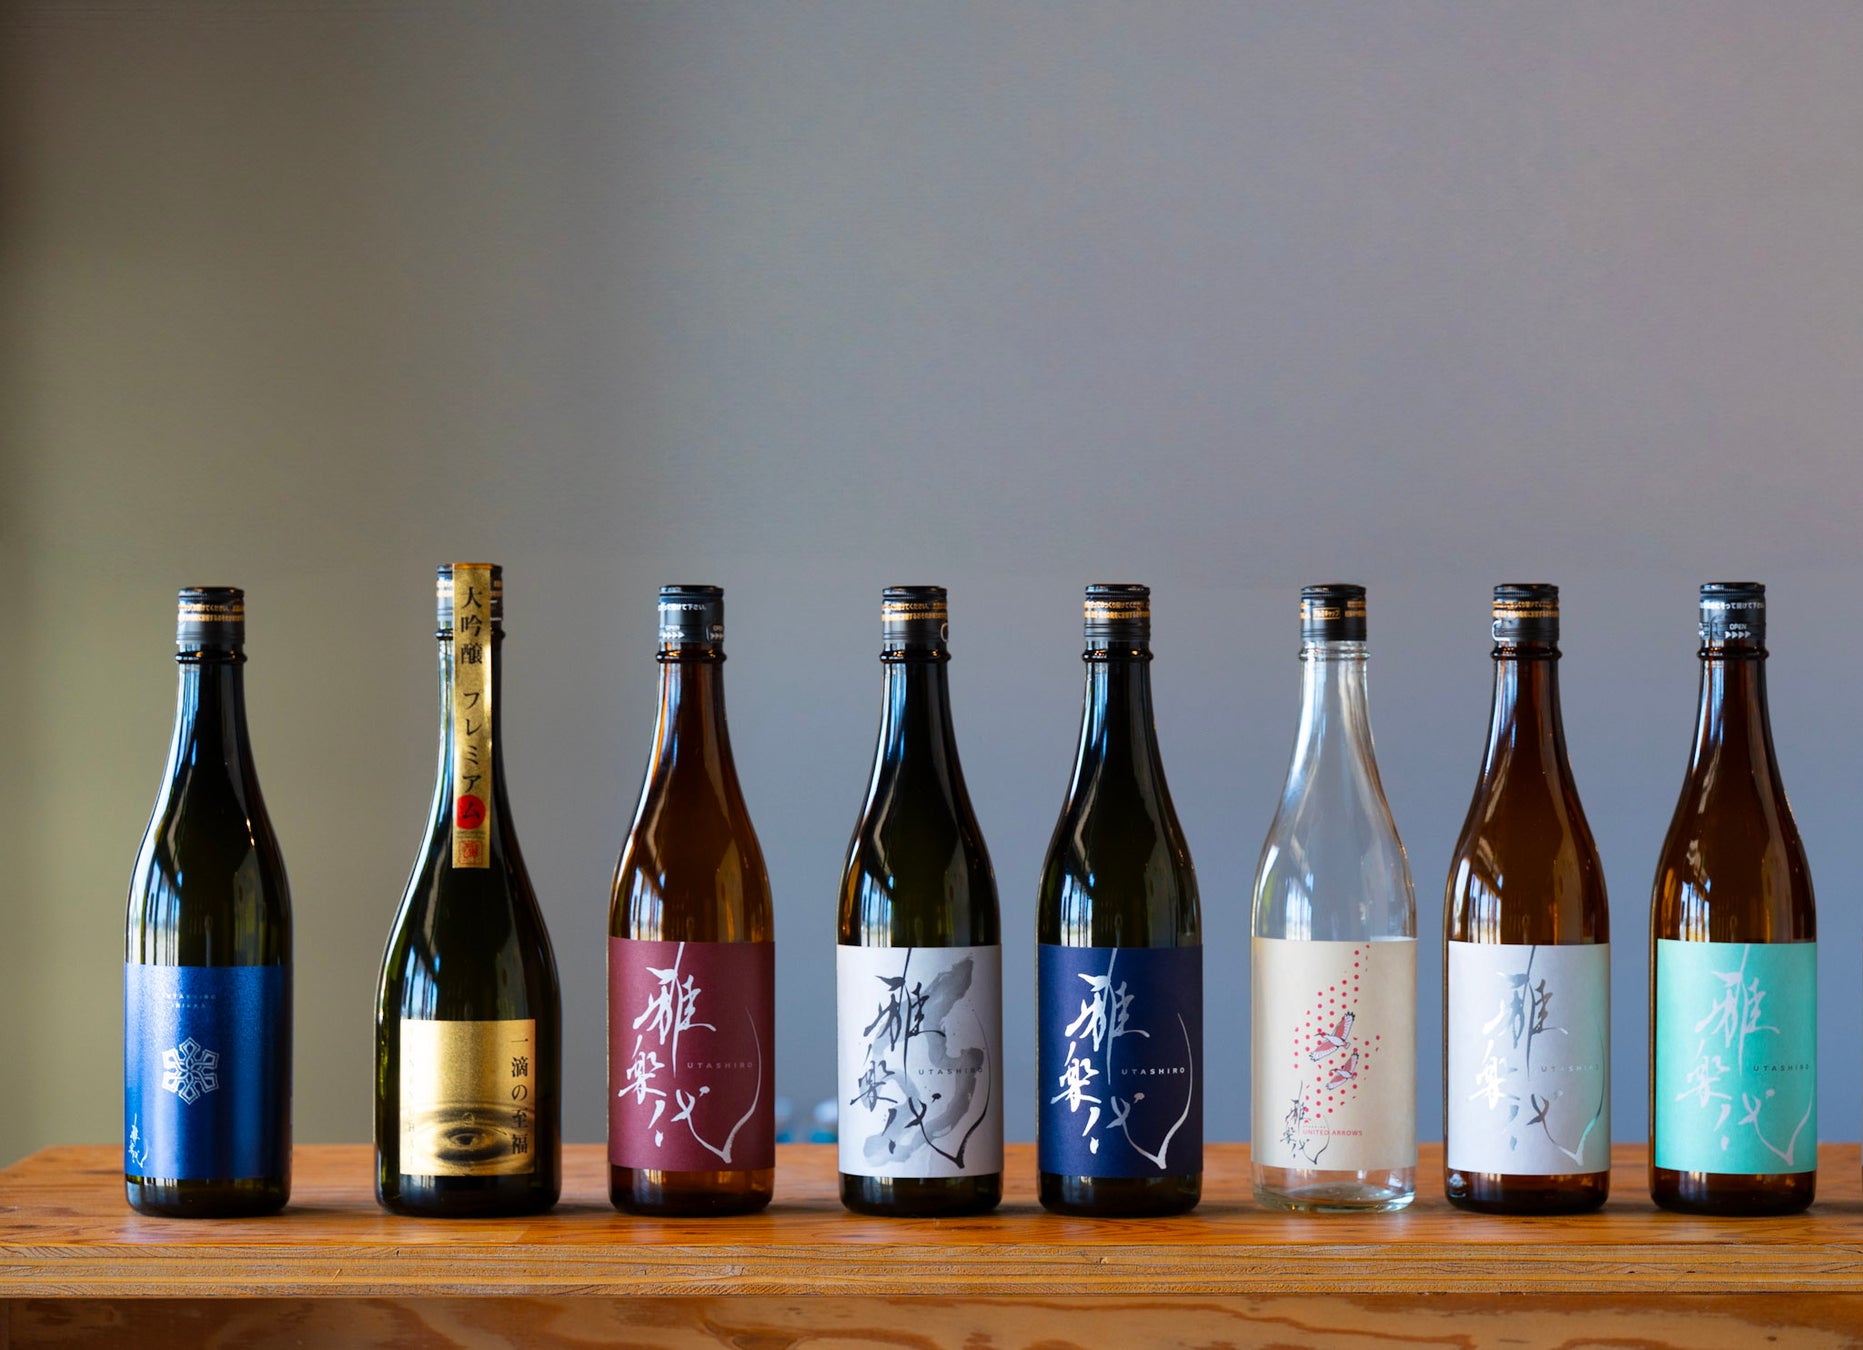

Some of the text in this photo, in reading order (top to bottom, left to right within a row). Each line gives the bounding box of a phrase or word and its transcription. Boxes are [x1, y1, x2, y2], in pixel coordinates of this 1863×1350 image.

[1729, 623, 1747, 631] OPEN
[686, 1061, 753, 1070] UTASHIRO
[918, 1066, 983, 1076] UTASHIRO
[1121, 1066, 1186, 1076] UTASHIRO
[510, 1038, 529, 1155] 一滴の至福
[1332, 1129, 1363, 1137] ARROWS
